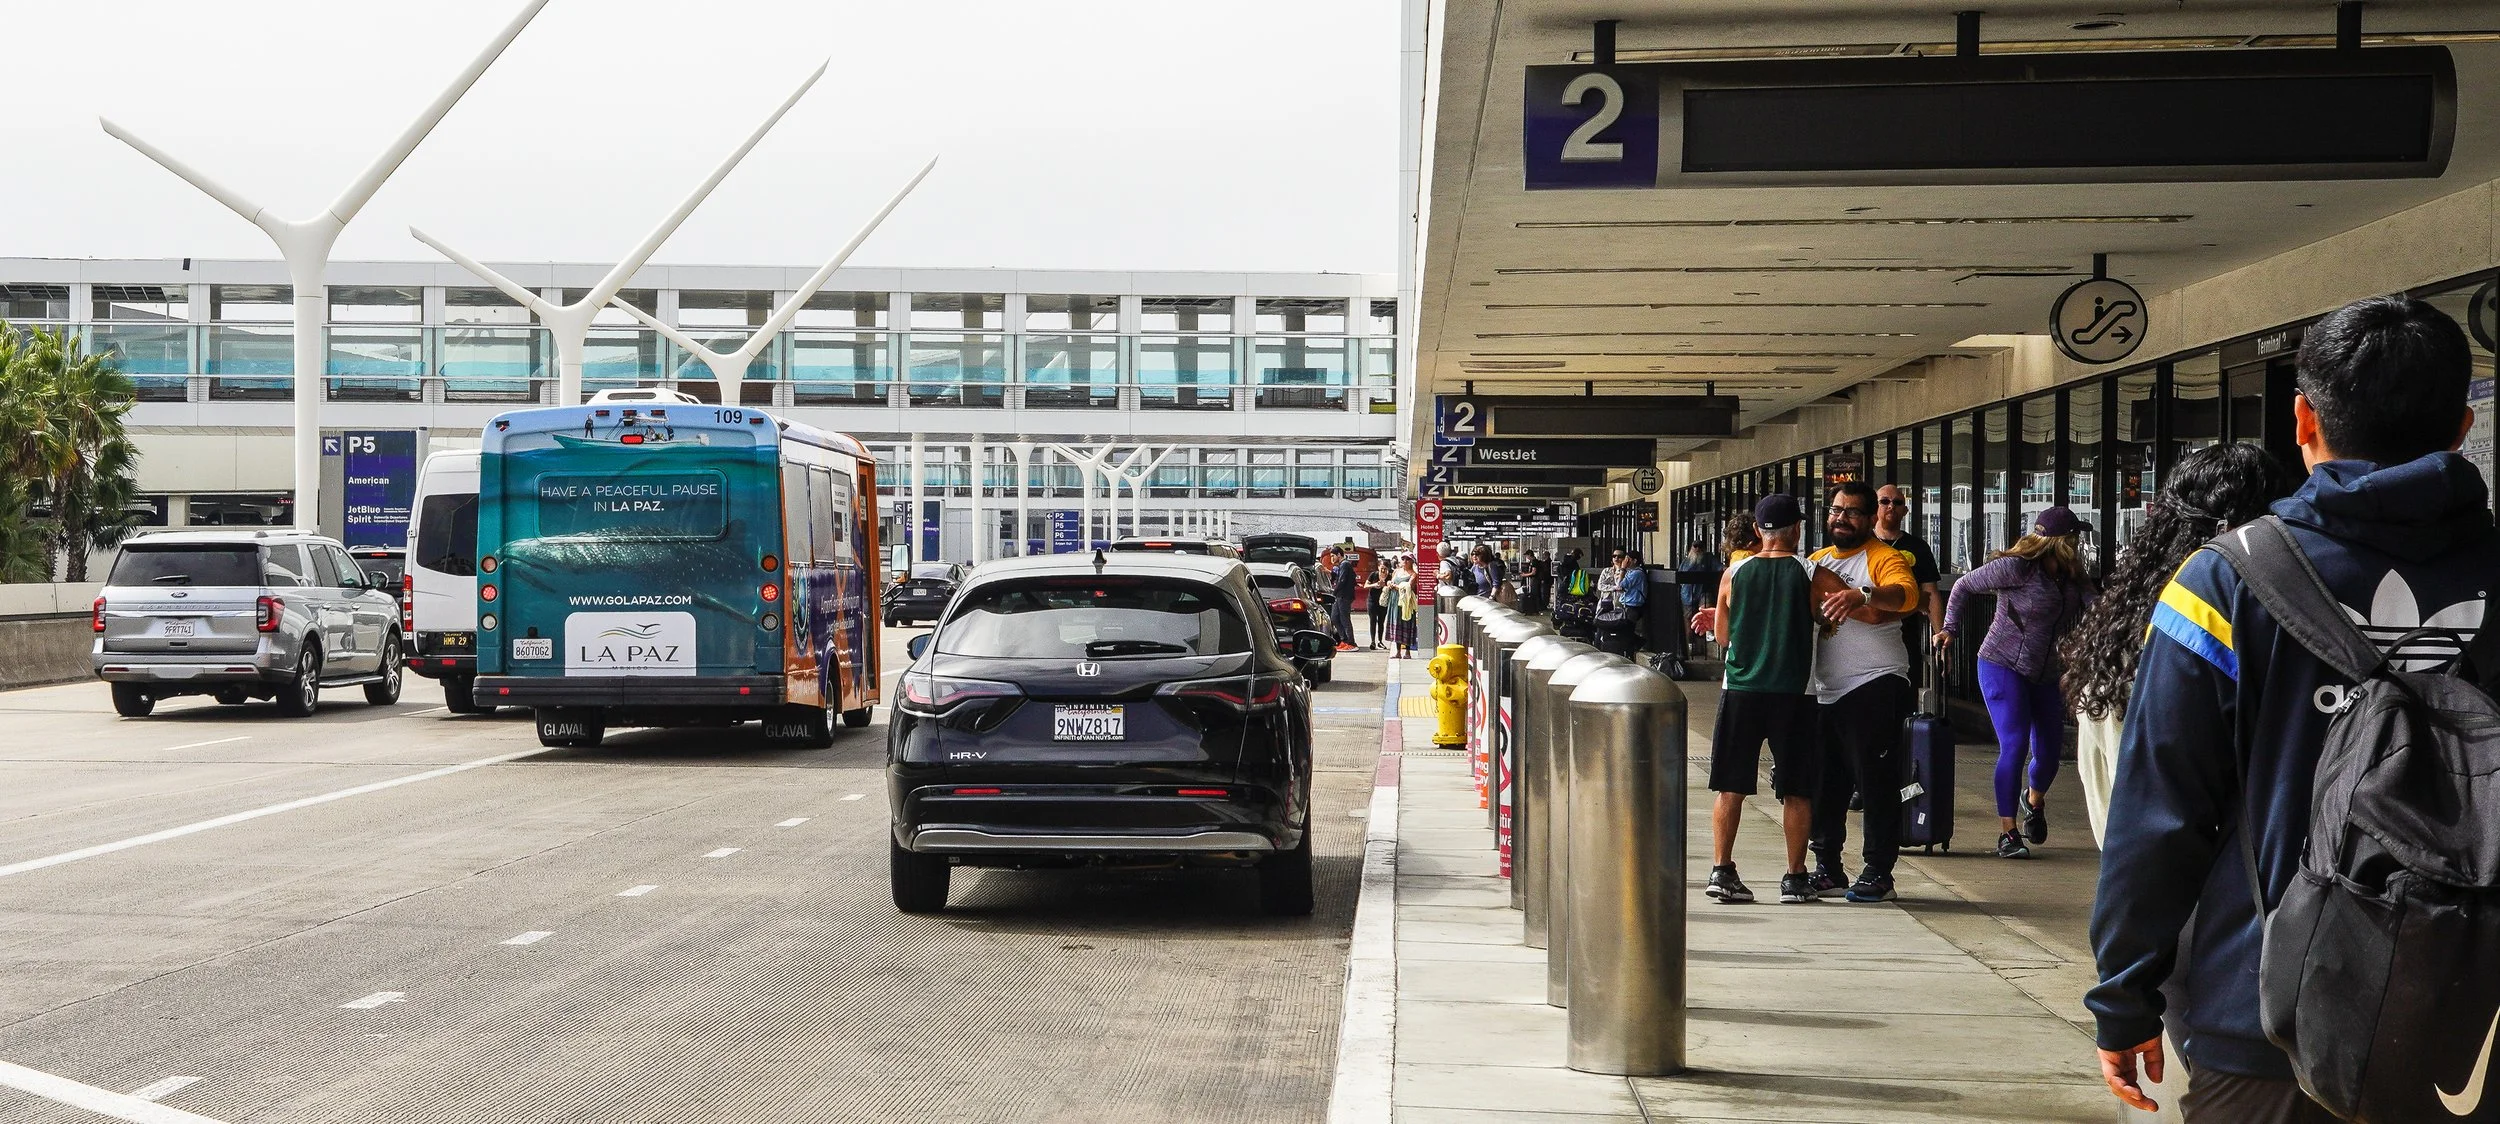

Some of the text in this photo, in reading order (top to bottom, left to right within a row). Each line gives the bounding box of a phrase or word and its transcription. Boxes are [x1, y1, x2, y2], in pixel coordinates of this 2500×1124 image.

[1561, 72, 1624, 162] 2
[714, 409, 743, 424] 109
[1454, 402, 1475, 432] 2
[349, 436, 376, 454] P5
[1441, 446, 1458, 462] 2
[1479, 448, 1537, 461] WestJet
[1433, 465, 1447, 482] 2
[348, 476, 390, 485] American
[541, 484, 718, 497] HAVE A PEACEFUL PAUSE
[1453, 485, 1529, 496] Virgin Atlantic
[347, 505, 381, 514] JetBlue
[593, 501, 665, 512] IN LA PAZ.
[347, 515, 372, 524] Spirit
[569, 595, 692, 606] WWW.GOLAPAZ.COM
[443, 637, 467, 646] HMR 29
[581, 645, 679, 662] LA PAZ
[543, 724, 587, 737] GLAVAL
[765, 725, 812, 738] GLAVAL
[1057, 718, 1121, 736] 9NWZ817
[950, 751, 987, 760] HR-V
